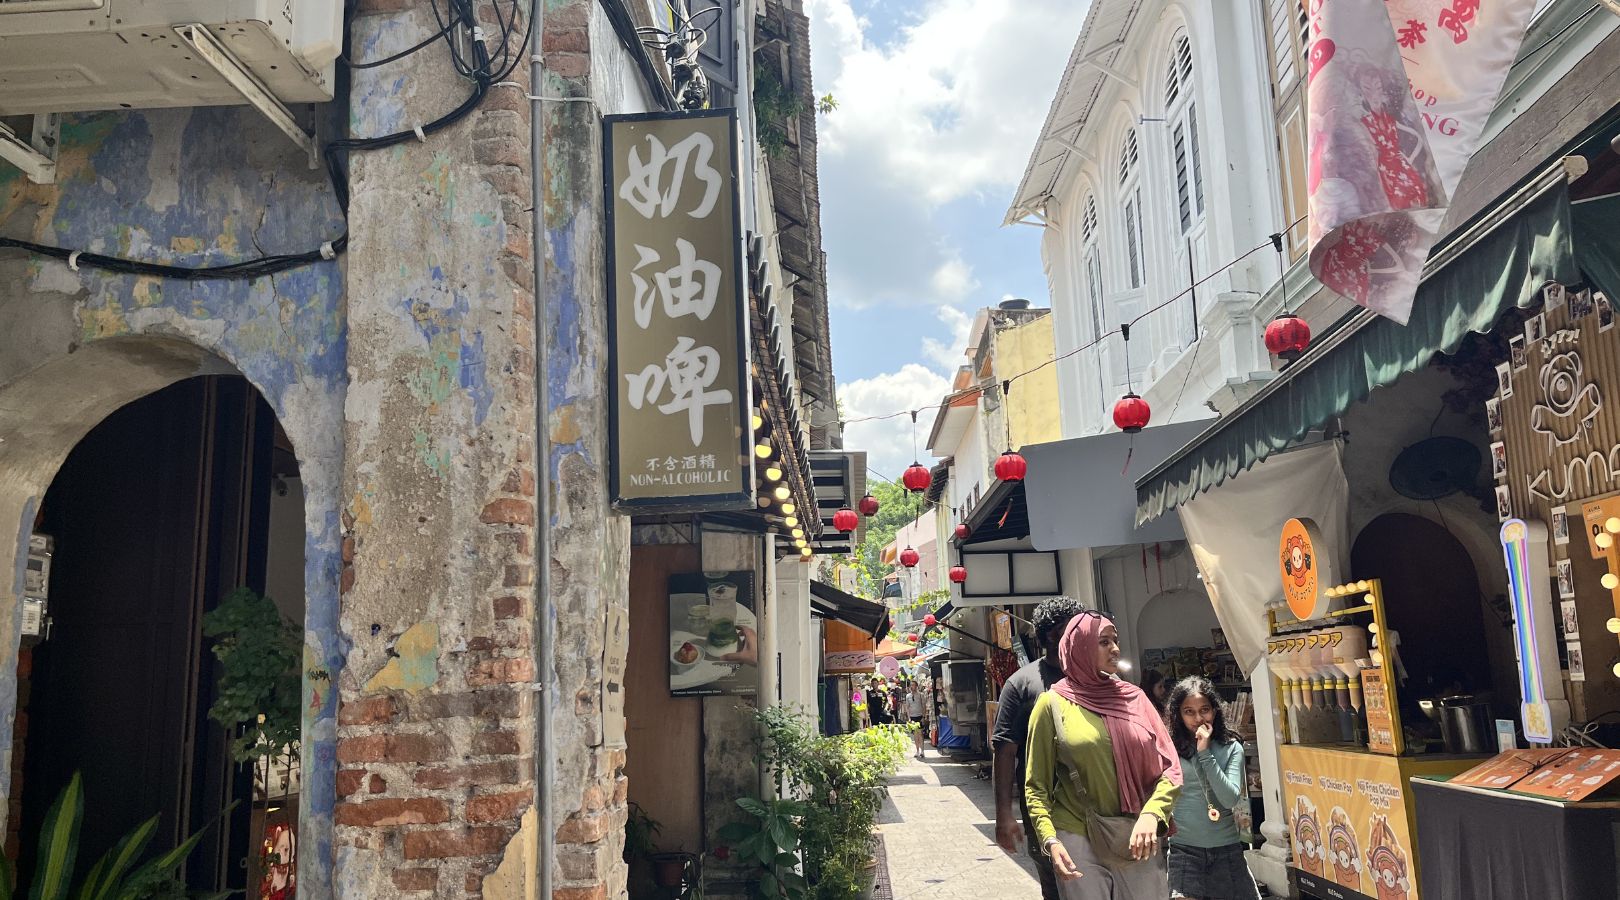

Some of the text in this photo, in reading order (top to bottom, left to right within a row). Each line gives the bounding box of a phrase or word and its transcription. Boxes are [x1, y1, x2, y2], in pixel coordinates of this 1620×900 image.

[619, 131, 732, 447] 奶油啤
[646, 454, 717, 471] 不含酒精
[630, 469, 731, 487] NON-ALCOHOLIC
